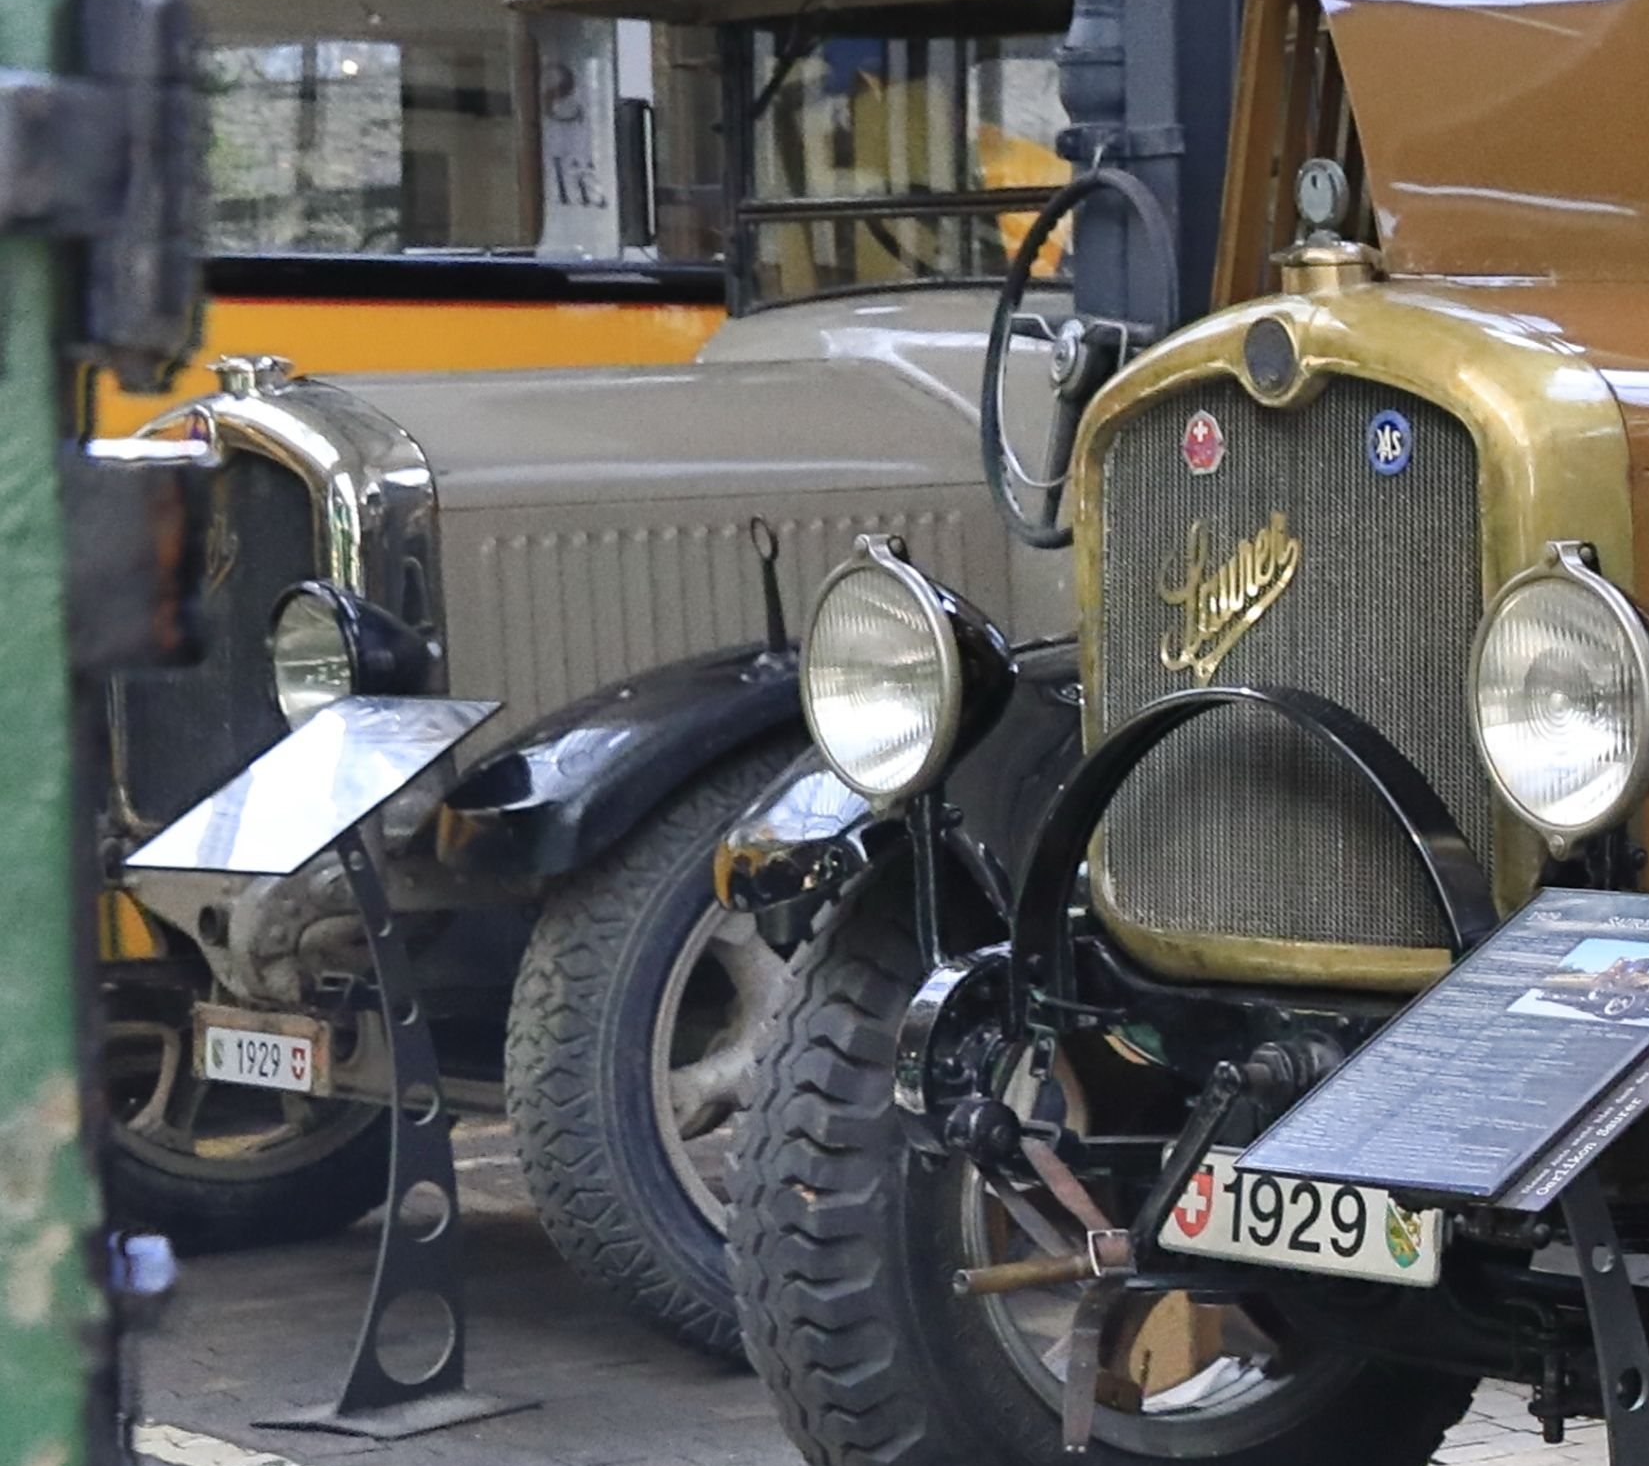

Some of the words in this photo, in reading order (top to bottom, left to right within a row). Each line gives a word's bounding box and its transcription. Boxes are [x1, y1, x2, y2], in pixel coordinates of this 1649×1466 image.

[1157, 509, 1299, 680] Saurer
[237, 1039, 281, 1078] 1929
[1536, 1141, 1597, 1197] Oerlikon
[1596, 1098, 1642, 1137] Saurer
[1222, 1172, 1368, 1260] 1929
